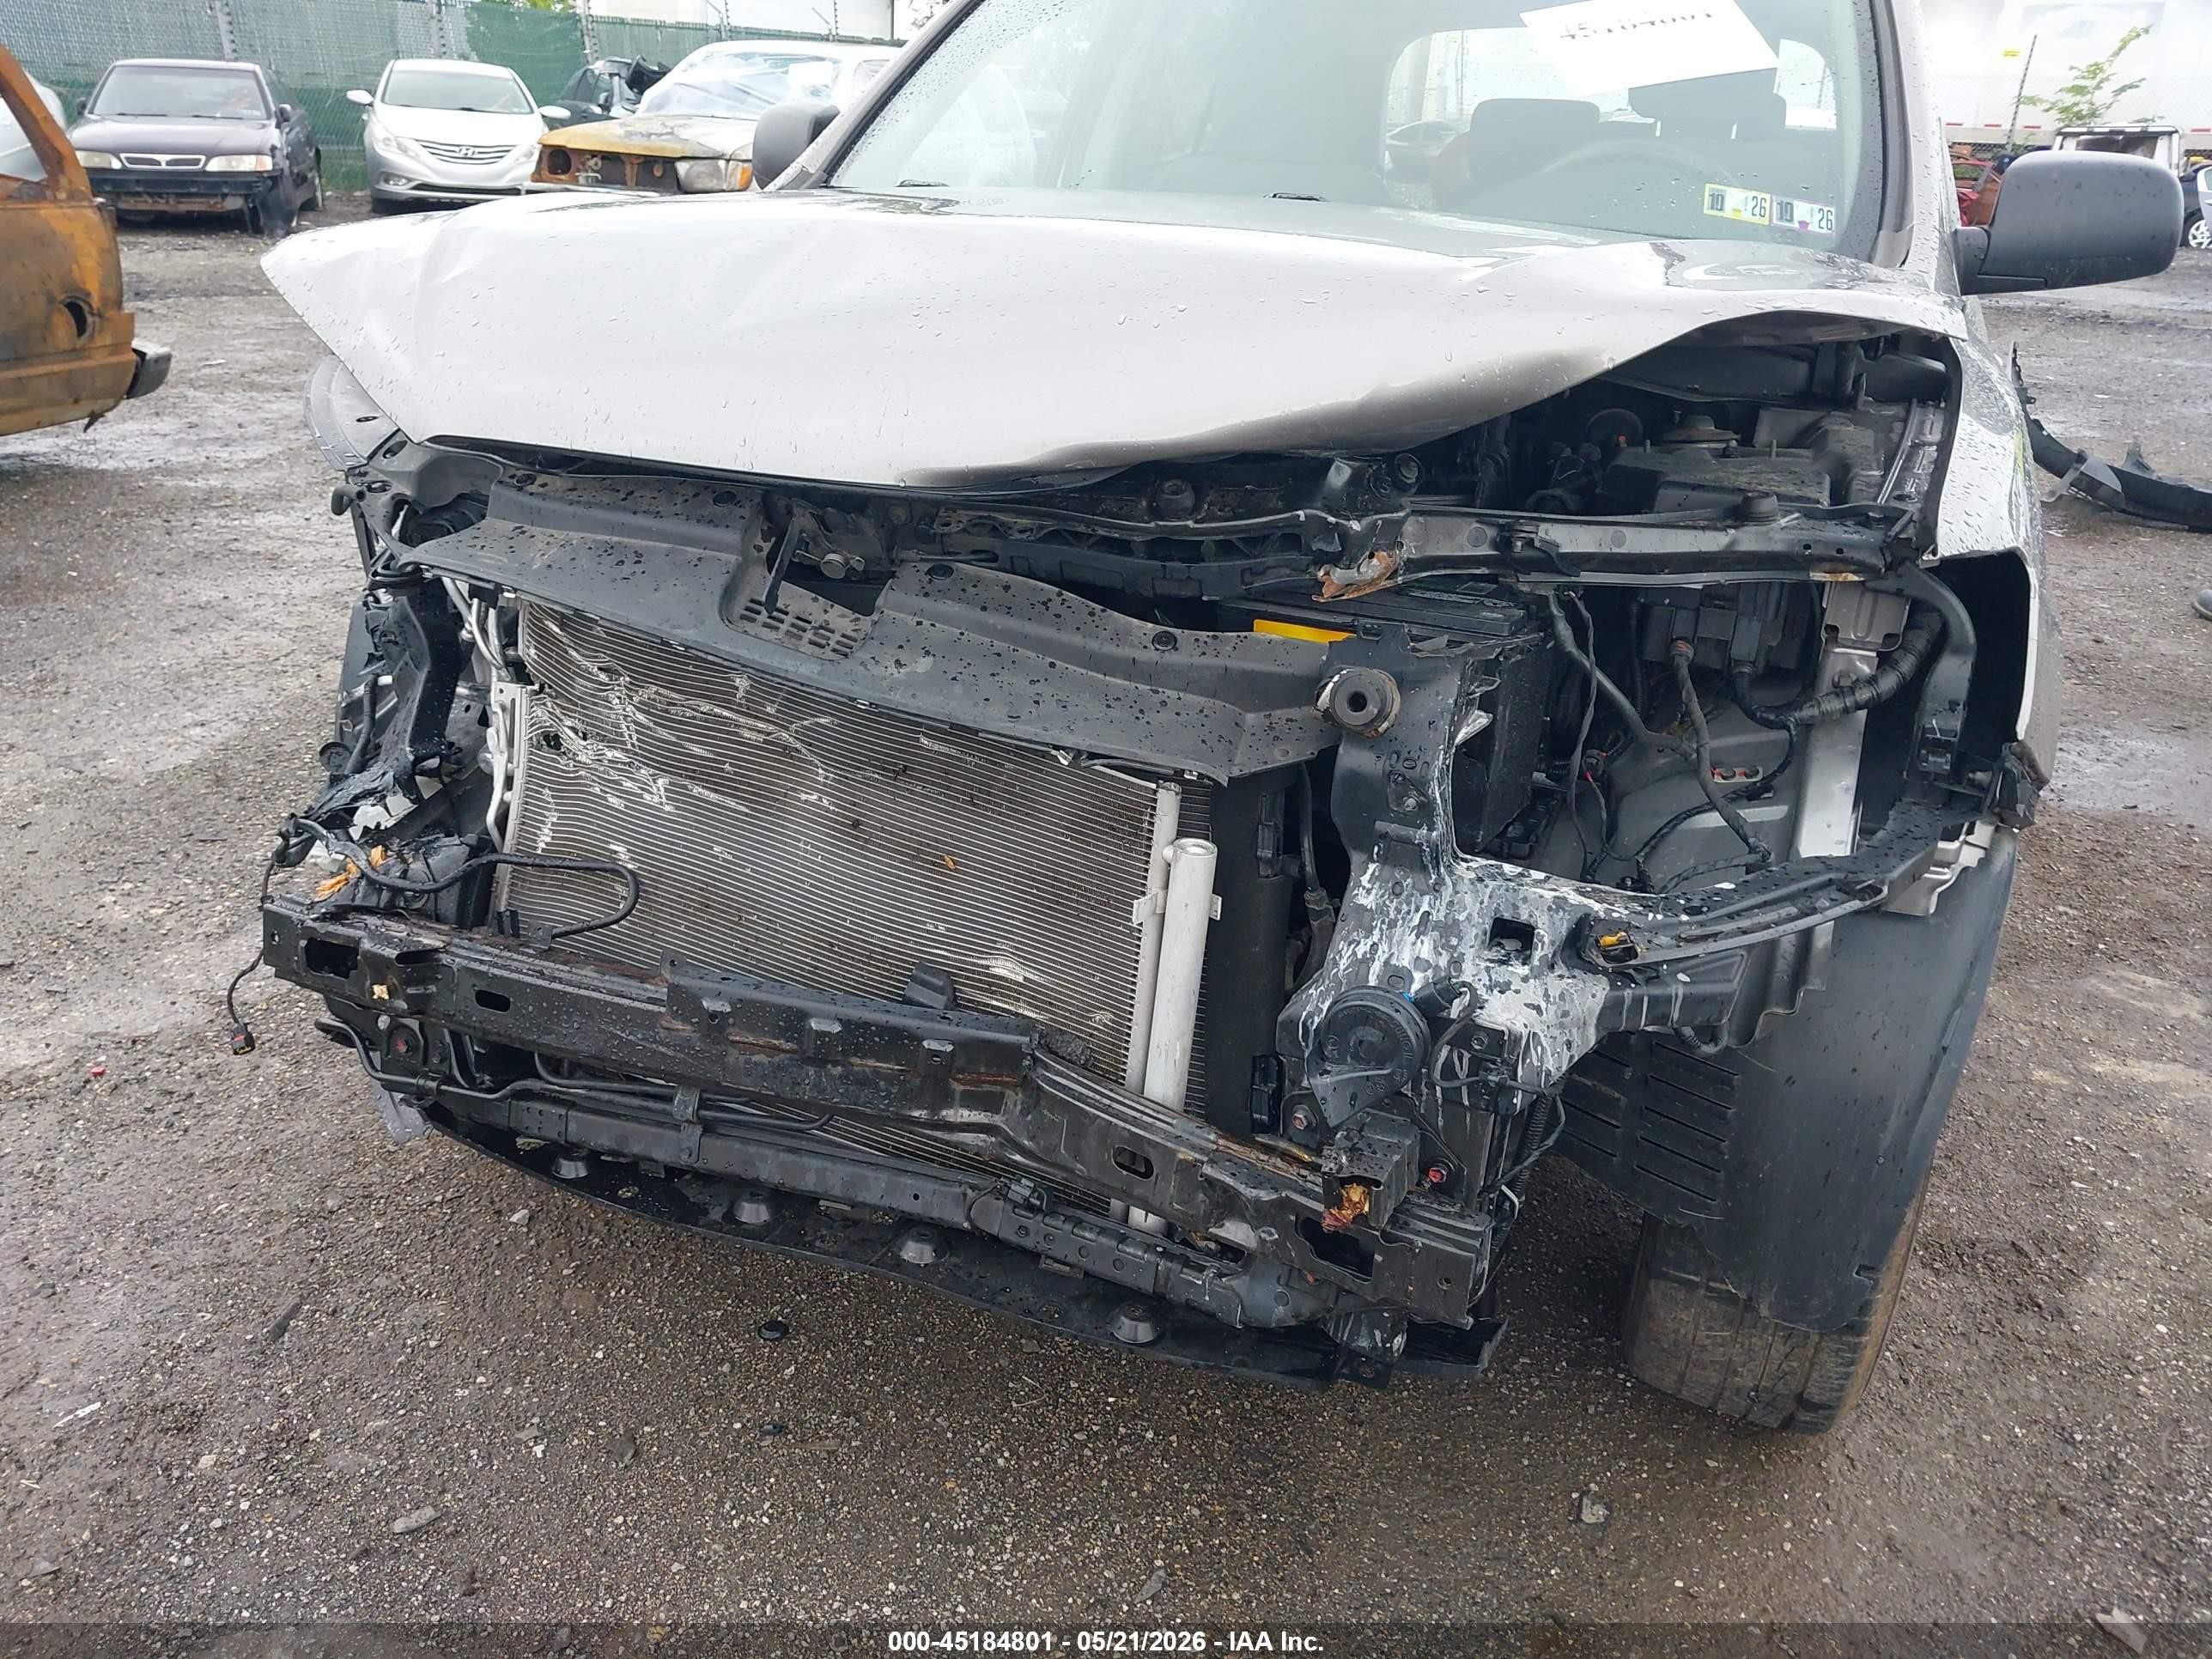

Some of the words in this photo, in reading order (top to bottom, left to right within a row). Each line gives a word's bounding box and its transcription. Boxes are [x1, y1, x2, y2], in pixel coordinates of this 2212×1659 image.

[1708, 191, 1725, 211] 10
[1751, 196, 1766, 218] 26
[1817, 208, 1833, 231] 26
